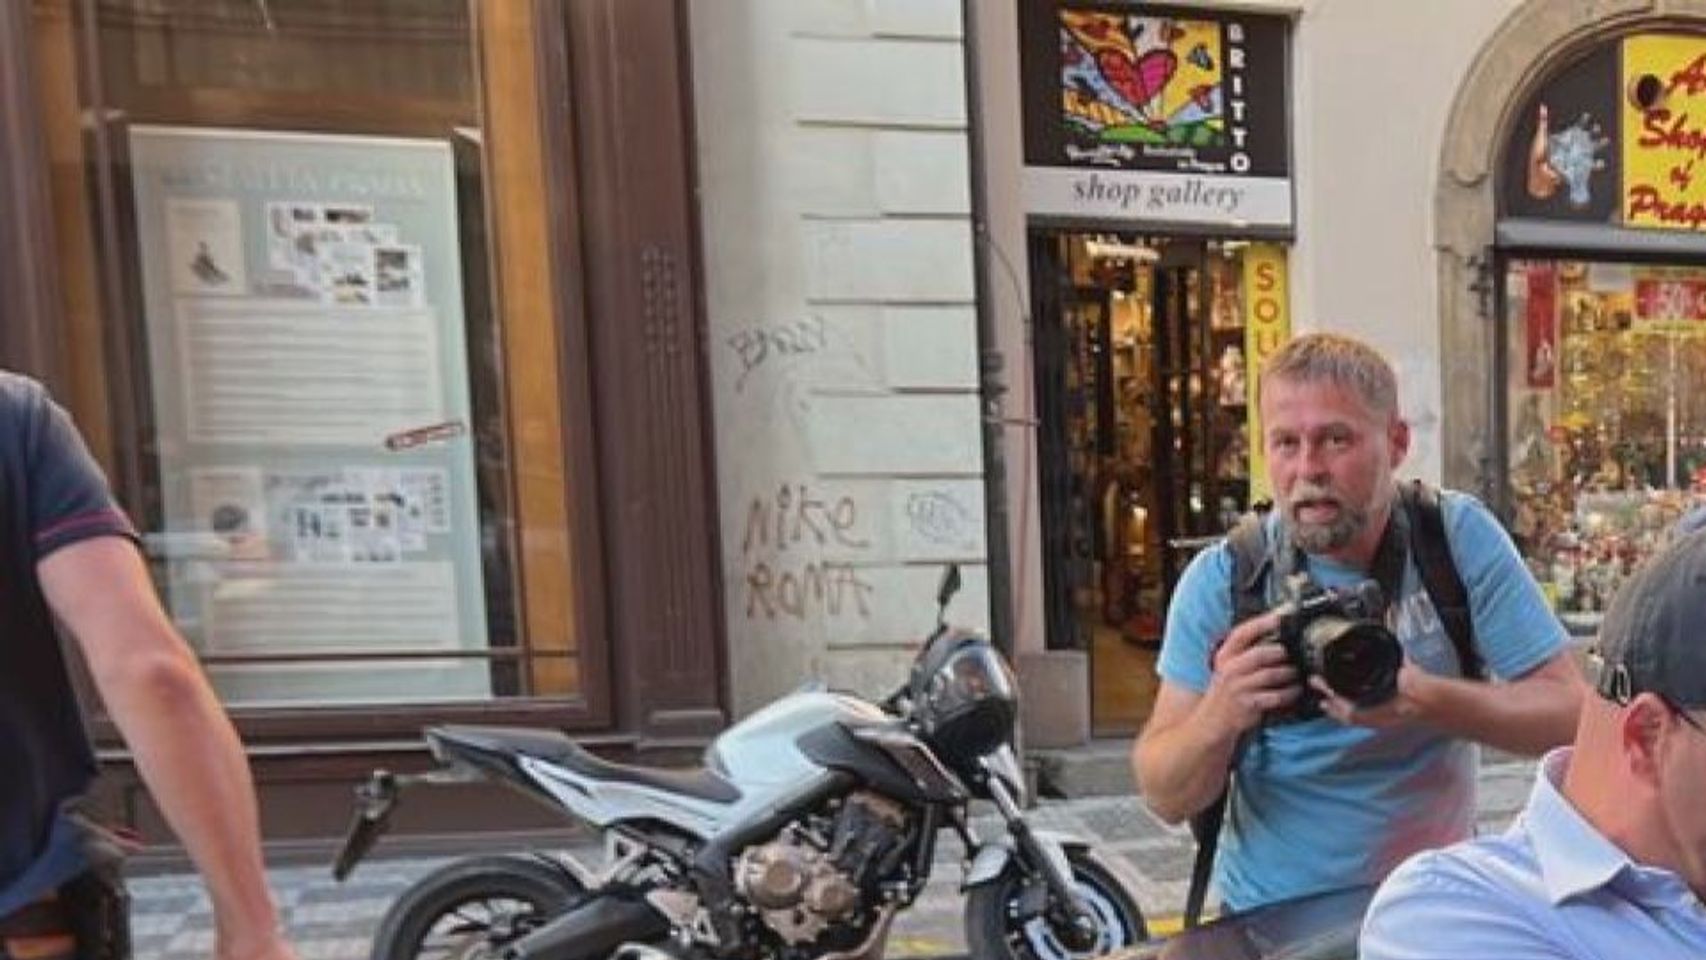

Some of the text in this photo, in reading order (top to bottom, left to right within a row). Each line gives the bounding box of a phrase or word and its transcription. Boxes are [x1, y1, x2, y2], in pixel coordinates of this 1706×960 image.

[1228, 23, 1251, 172] BRITTO
[1073, 173, 1246, 212] shop gallery
